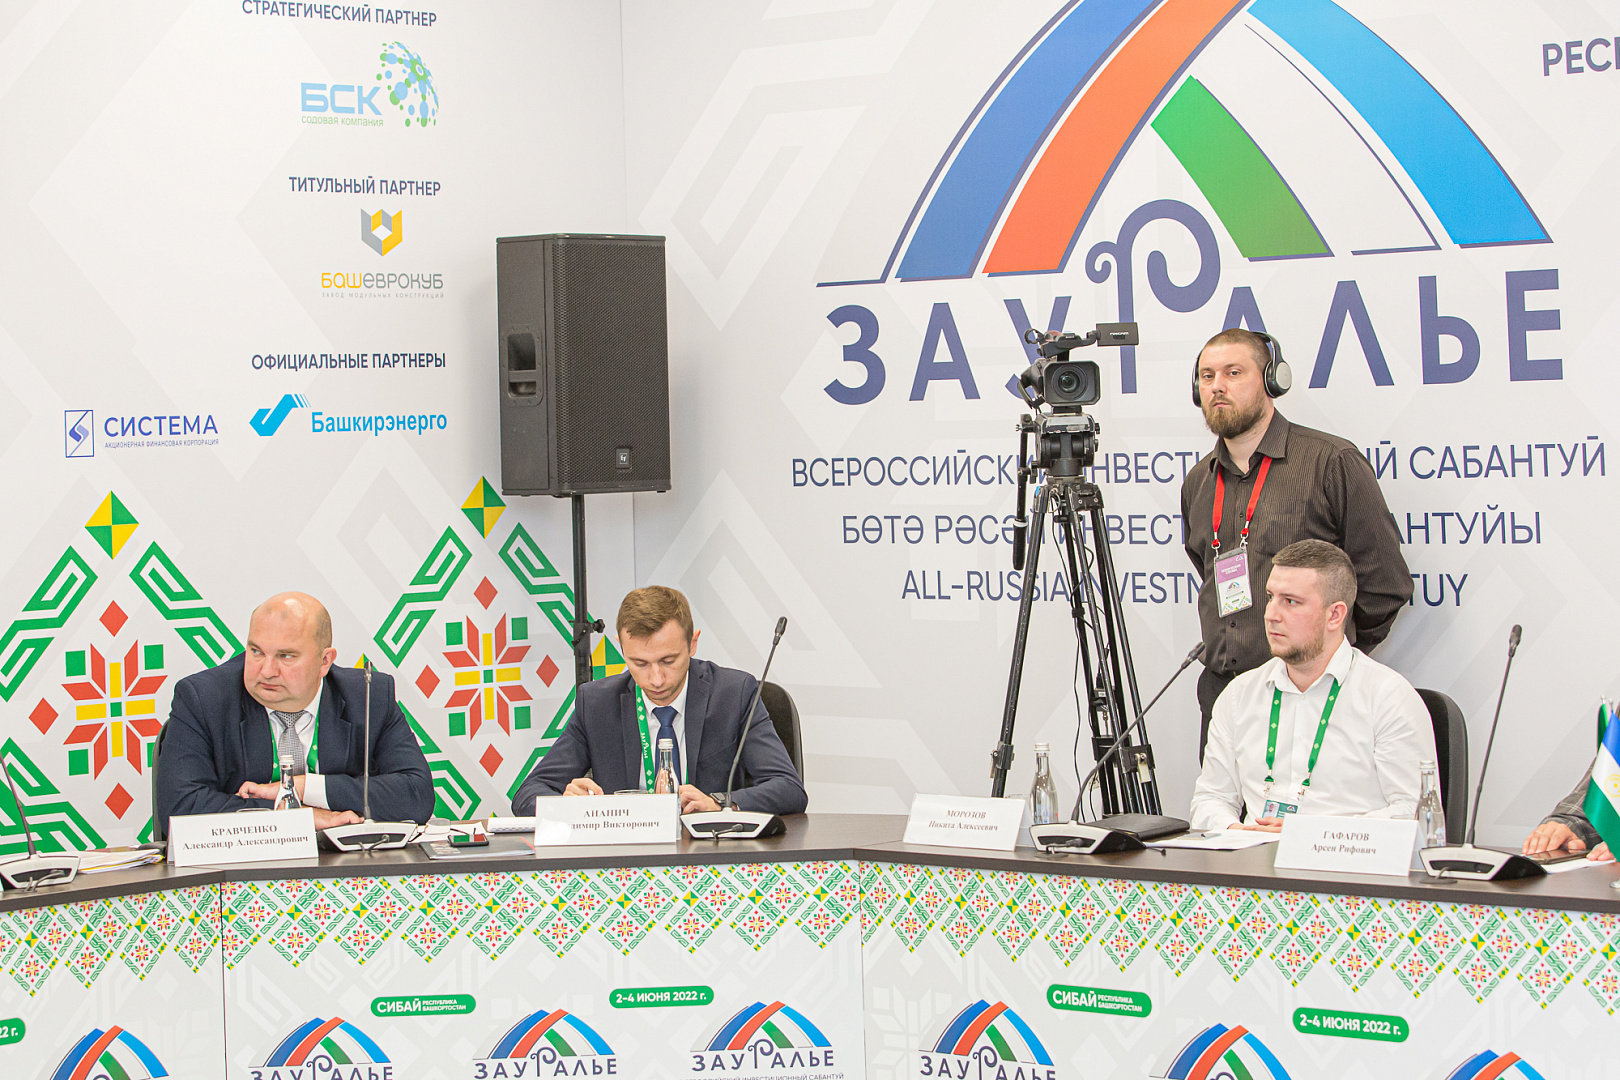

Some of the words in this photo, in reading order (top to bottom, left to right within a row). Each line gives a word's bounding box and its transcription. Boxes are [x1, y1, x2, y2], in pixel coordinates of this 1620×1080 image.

[241, 0, 371, 23] СТРАТЕГИЧЕСКИЙ
[375, 8, 437, 27] ПАРТНЕР
[301, 82, 382, 115] БСК
[301, 115, 339, 125] содовая
[341, 117, 384, 127] компания
[288, 175, 376, 195] ТИТУЛЬНЫЙ
[379, 179, 441, 197] ПАРТНЕР
[251, 353, 369, 372] ОФИЦИАЛЬНЫЕ
[372, 352, 446, 369] ПАРТНЕРЫ
[103, 414, 219, 438] СИСТЕМА
[311, 411, 448, 437] Башкирэнерго
[104, 440, 145, 450] АКЦИОНЕРНАЯ
[146, 439, 183, 448] ФИНАНСОВАЯ
[183, 438, 219, 447] КОРПОРАЦИЯ
[1409, 435, 1606, 480] САБАНТУЙ
[584, 808, 629, 818] АНАНИЧ
[946, 809, 987, 819] МОРОЗОВ
[211, 825, 278, 837] КРАВЧЕНКО
[603, 820, 660, 830] Викторович
[928, 820, 956, 829] Никита
[956, 821, 998, 832] Алексеевич
[1323, 830, 1370, 842] ГАФАРОВ
[182, 840, 234, 851] Александр
[236, 835, 309, 847] Александрович
[1311, 843, 1337, 854] Арсен
[1338, 844, 1377, 856] Рифович
[422, 998, 458, 1006] РЕСПУБЛИКА
[636, 991, 671, 1003] ИЮНЯ
[672, 990, 698, 1002] 2022
[699, 992, 707, 1001] г.
[1051, 988, 1099, 1009] СИБАЙ
[1097, 994, 1133, 1004] РЕСПУБЛИКА
[375, 996, 422, 1013] СИБАЙ
[422, 1004, 467, 1012] БАШКОРТОСТАН
[1098, 1001, 1143, 1013] БАШКОРТОСТАН
[11, 1027, 19, 1037] г.
[1322, 1015, 1361, 1032] ИЮНЯ
[1360, 1017, 1393, 1037] 2022
[1392, 1025, 1402, 1036] г.
[690, 1038, 836, 1073] ЗАУРАЛЬЕ
[473, 1046, 619, 1080] ЗАУРАЛЬЕ
